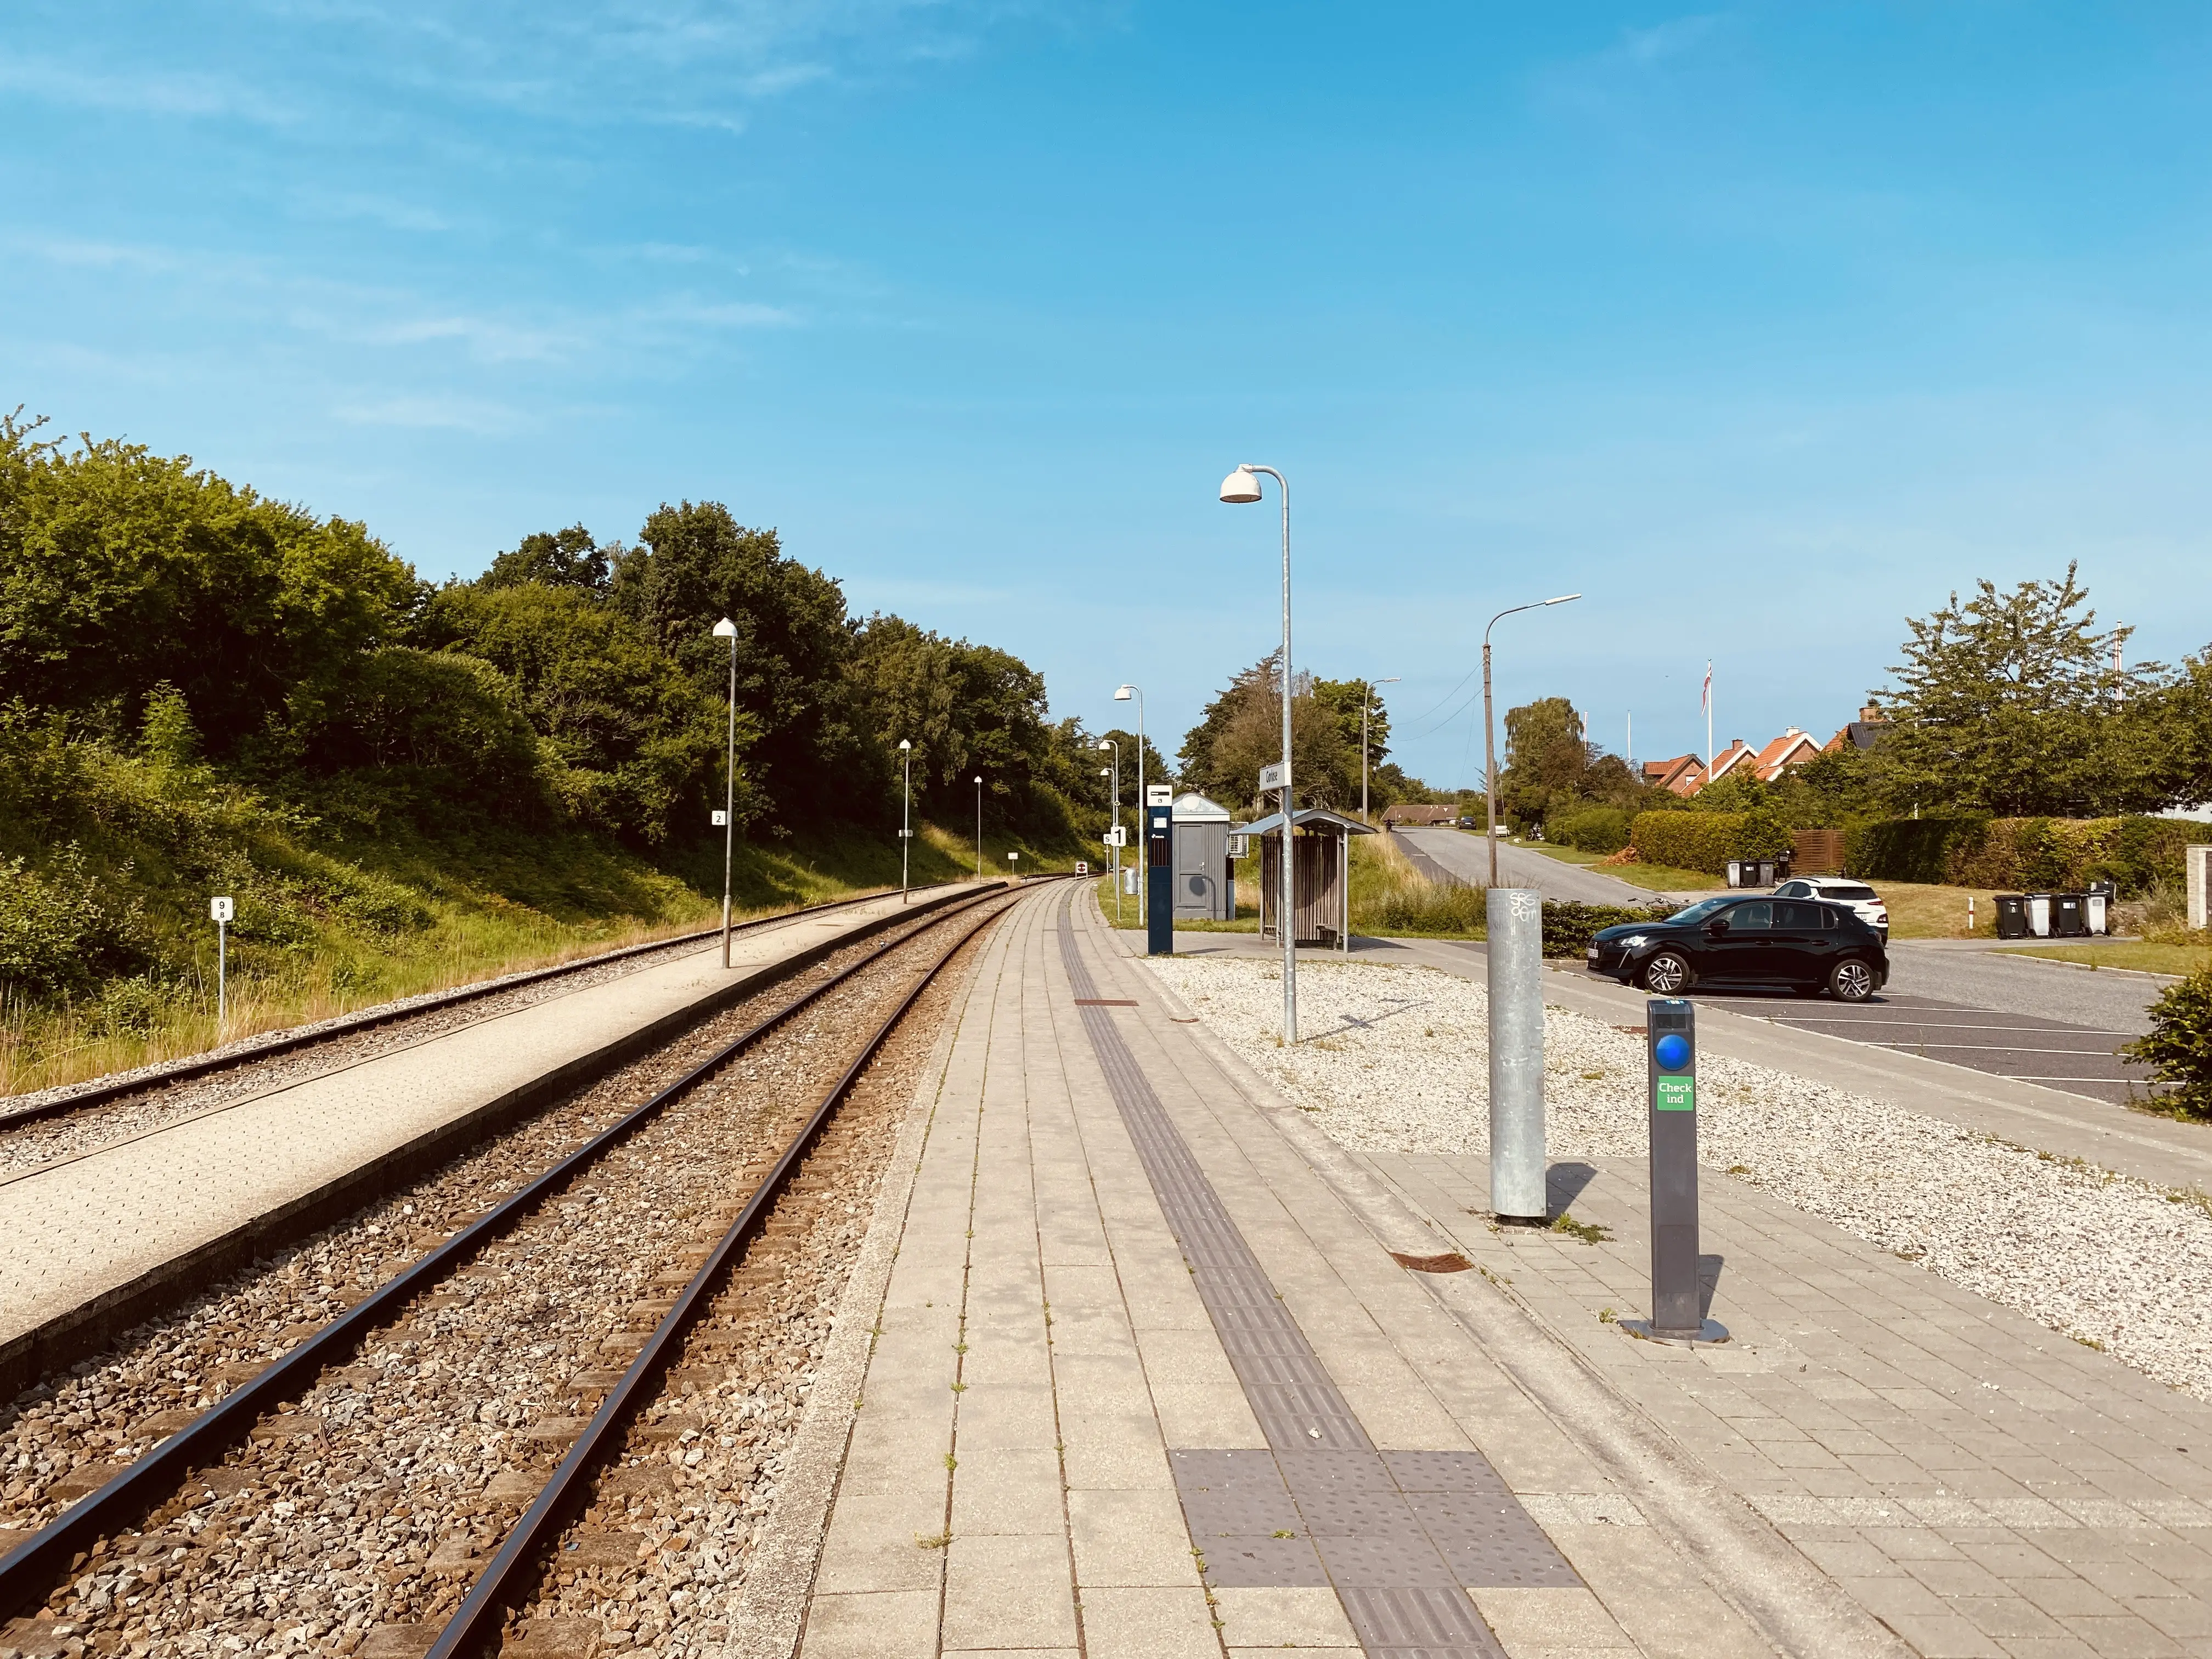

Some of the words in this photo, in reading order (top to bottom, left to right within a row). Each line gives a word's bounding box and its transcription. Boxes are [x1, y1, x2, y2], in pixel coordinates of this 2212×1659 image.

[1114, 829, 1121, 844] 1
[219, 901, 225, 909] 9
[1659, 1082, 1692, 1093] Check
[1667, 1094, 1684, 1103] ind
